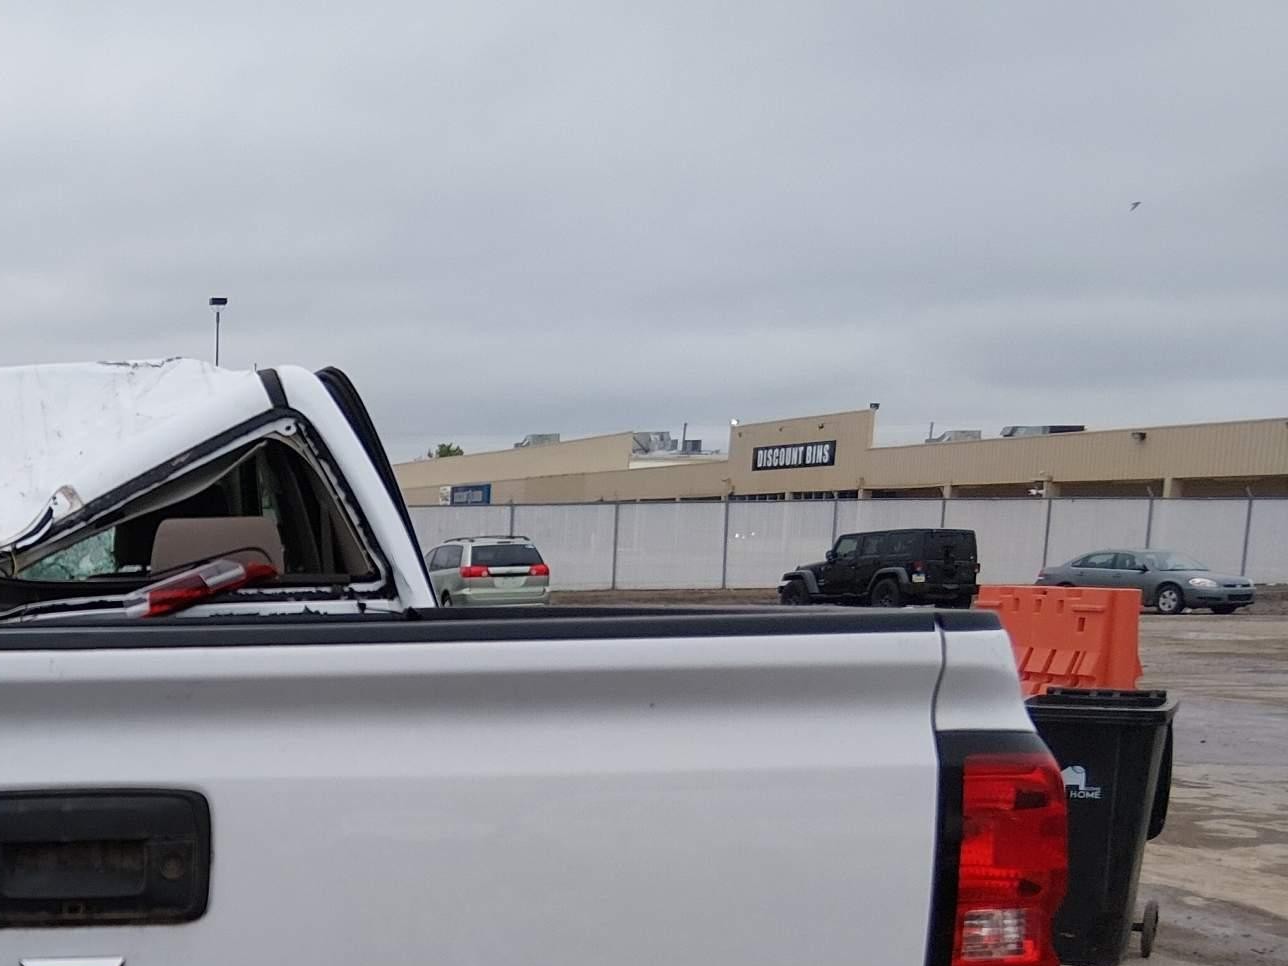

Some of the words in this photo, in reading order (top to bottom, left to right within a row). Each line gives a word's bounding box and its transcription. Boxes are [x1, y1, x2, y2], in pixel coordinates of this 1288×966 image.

[757, 446, 805, 468] DISCOUNT
[805, 444, 830, 464] BINS
[1069, 790, 1102, 799] HOME
